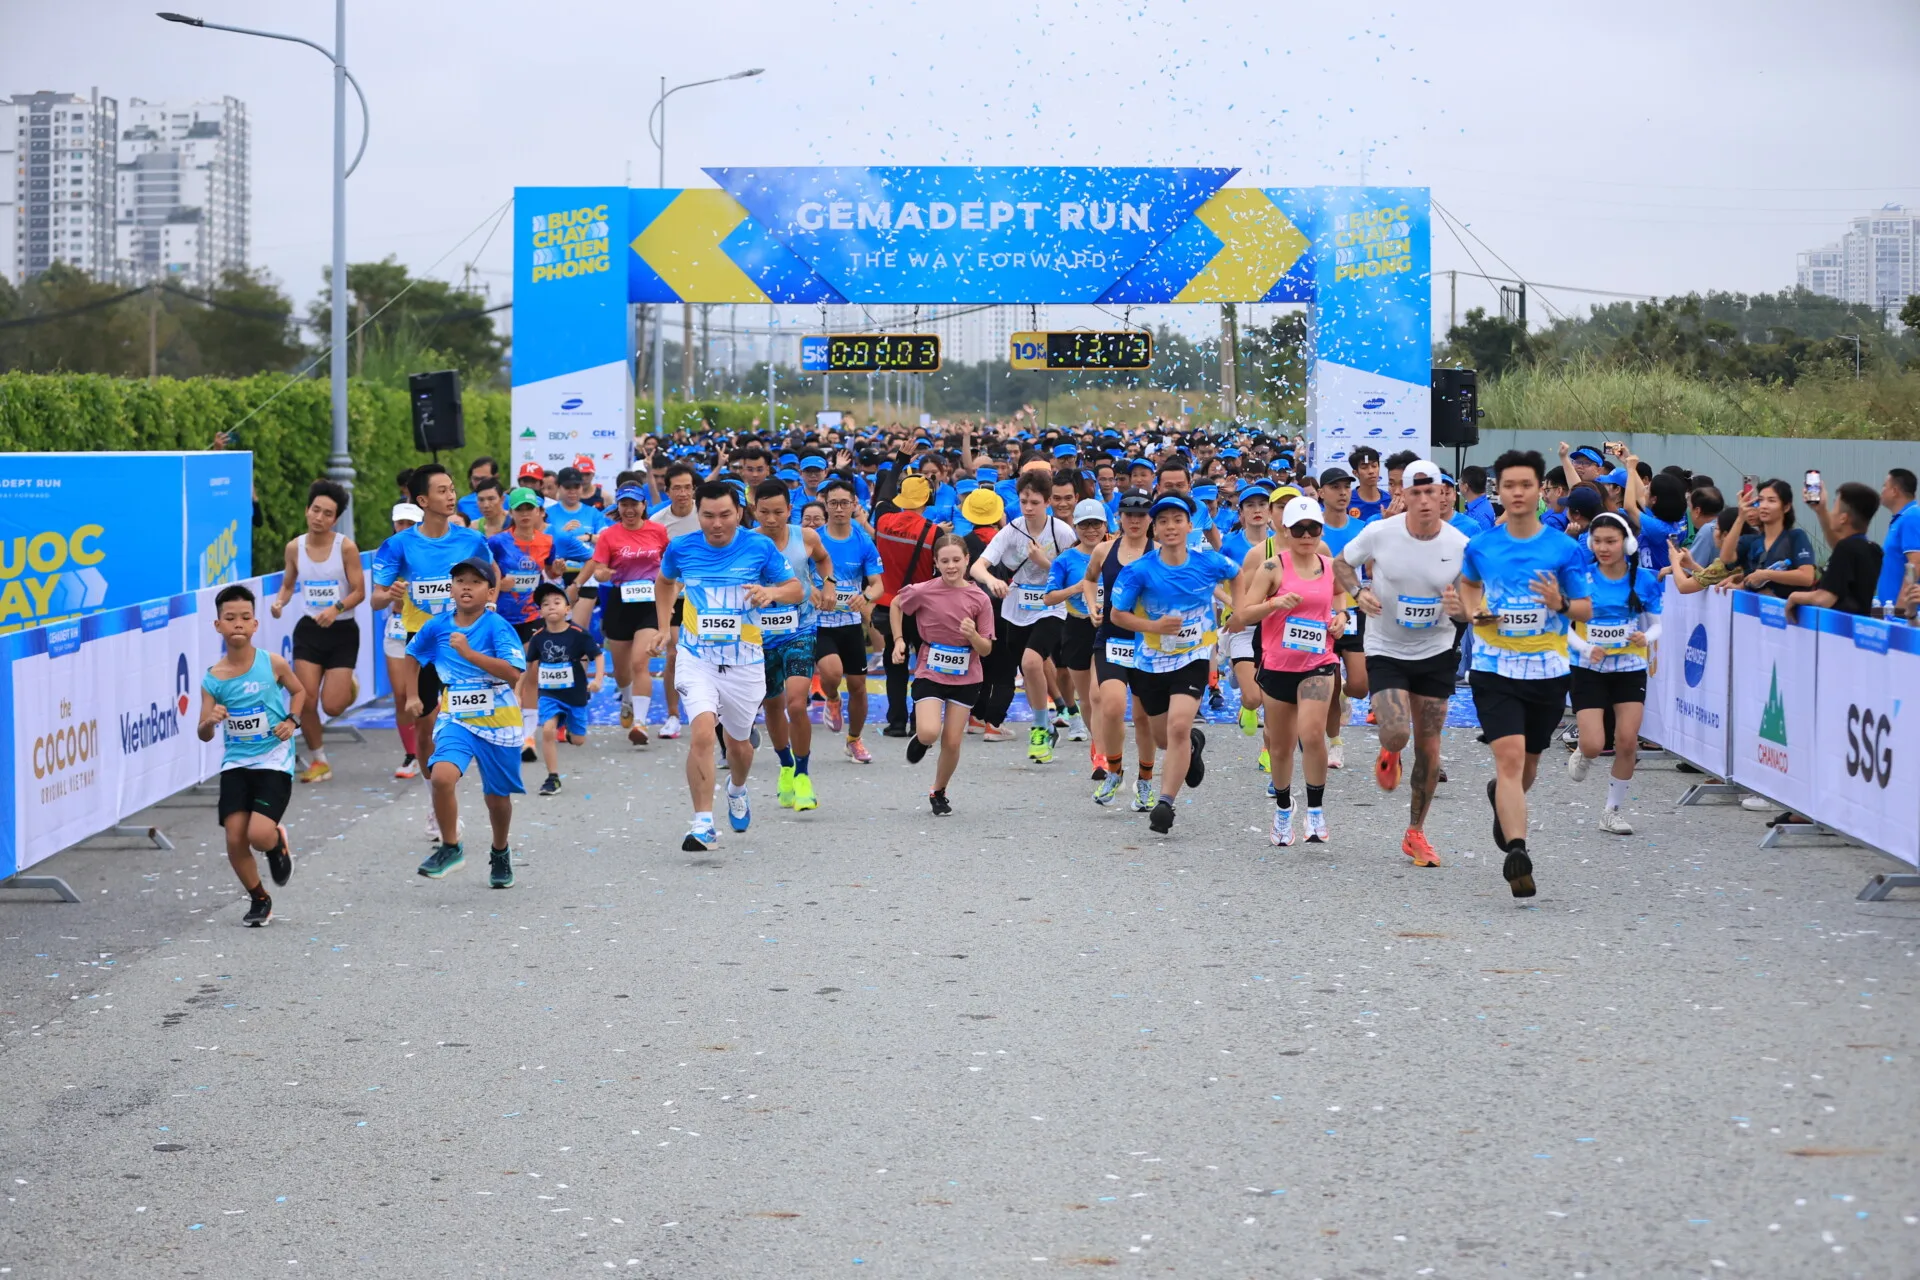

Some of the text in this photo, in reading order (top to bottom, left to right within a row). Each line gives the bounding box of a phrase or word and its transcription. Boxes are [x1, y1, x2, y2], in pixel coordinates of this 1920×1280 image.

[547, 204, 609, 229] BUOC
[796, 202, 1149, 230] GEMADEPT RUN
[533, 224, 590, 248] CHAY
[1335, 224, 1392, 248] CHAY
[561, 237, 609, 260] TIEN
[1363, 237, 1411, 260] TIEN
[849, 252, 1107, 268] THE WAY FORWARD
[532, 254, 610, 283] PHONG
[1335, 255, 1412, 283] PHONG
[548, 431, 570, 441] BIDV
[592, 429, 616, 437] CEH
[548, 453, 565, 461] SSG
[0, 479, 62, 488] DEPT RUN
[515, 577, 536, 585] 2167
[308, 588, 334, 597] 51565
[418, 583, 453, 594] 51748
[625, 586, 653, 595] 51902
[1024, 592, 1044, 601] 5154
[1404, 606, 1435, 617] 51731
[702, 618, 735, 628] 51562
[761, 615, 793, 626] 51829
[1503, 613, 1538, 625] 51552
[1177, 627, 1198, 638] 474
[1289, 628, 1322, 642] 51290
[1590, 628, 1625, 638] 52008
[1111, 647, 1134, 658] 5128
[933, 653, 965, 665] 51983
[541, 670, 568, 679] 51483
[452, 693, 487, 706] 51482
[60, 696, 72, 719] the
[120, 695, 180, 756] VietinBank
[228, 717, 260, 731] 51687
[33, 718, 98, 780] cocoon
[1846, 703, 1892, 790] SSG
[40, 780, 67, 805] ORIGINAL
